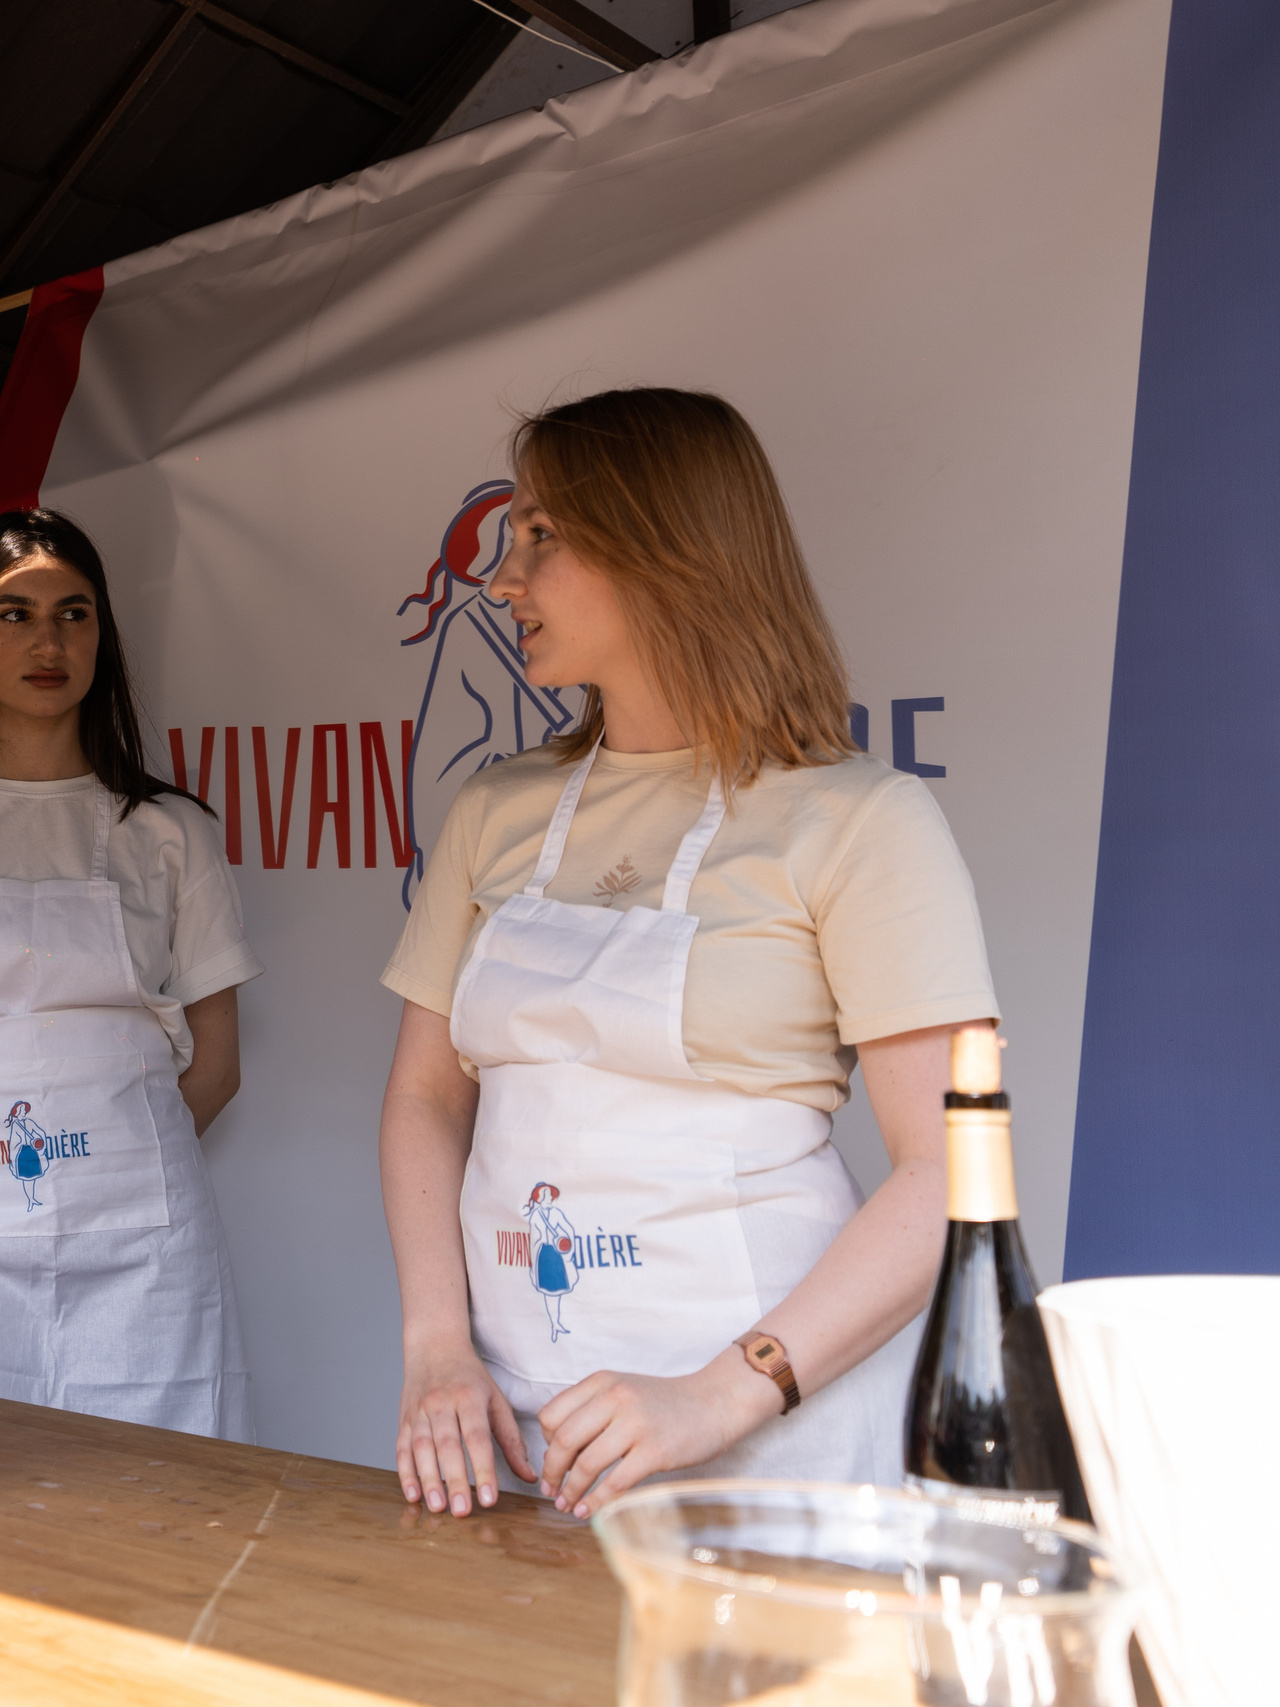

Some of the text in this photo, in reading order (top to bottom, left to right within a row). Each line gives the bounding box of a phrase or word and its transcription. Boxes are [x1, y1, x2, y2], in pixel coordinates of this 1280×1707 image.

[168, 720, 416, 870] VIVAN
[45, 1129, 91, 1161] DIÈRE
[496, 1226, 643, 1270] VIVAN DIÈRE
